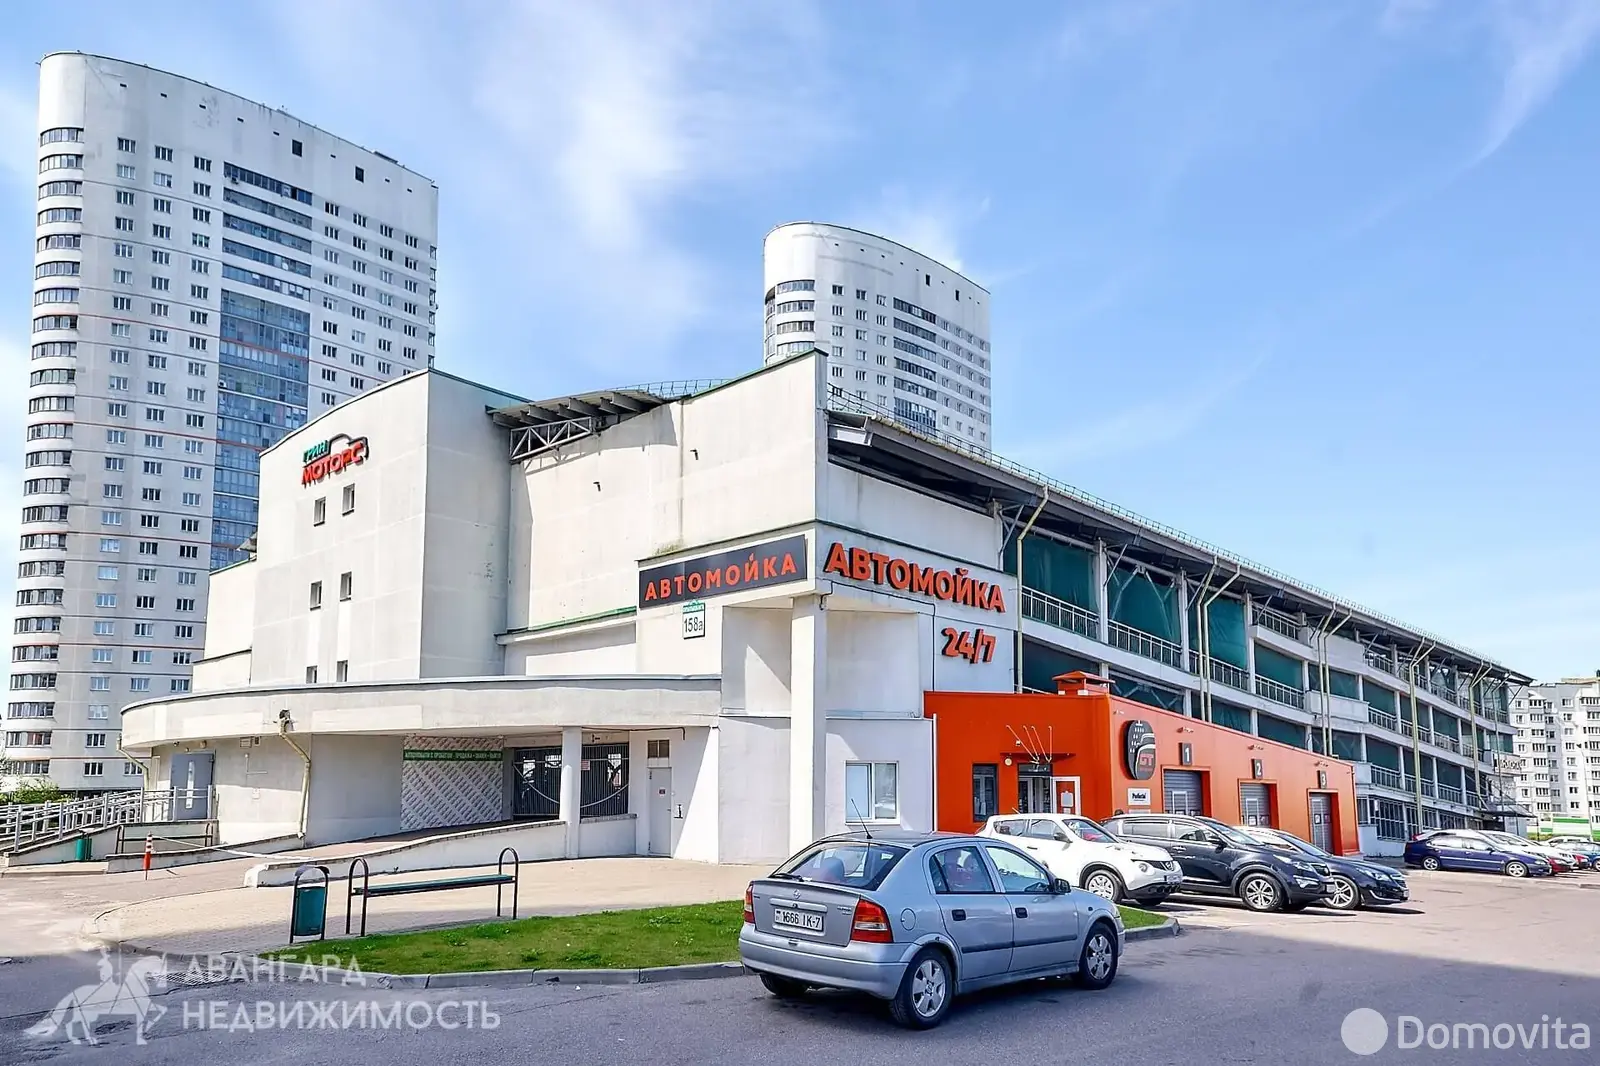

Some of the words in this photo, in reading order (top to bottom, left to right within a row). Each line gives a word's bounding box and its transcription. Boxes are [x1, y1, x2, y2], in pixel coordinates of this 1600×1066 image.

[302, 441, 364, 487] МОТОРС
[645, 552, 797, 601] АВТОМОЙКА
[824, 542, 1006, 613] АВТОМОЙКА
[684, 616, 704, 633] 158а
[941, 626, 997, 664] 24/7
[1184, 746, 1190, 762] 1
[1256, 762, 1262, 776] 2
